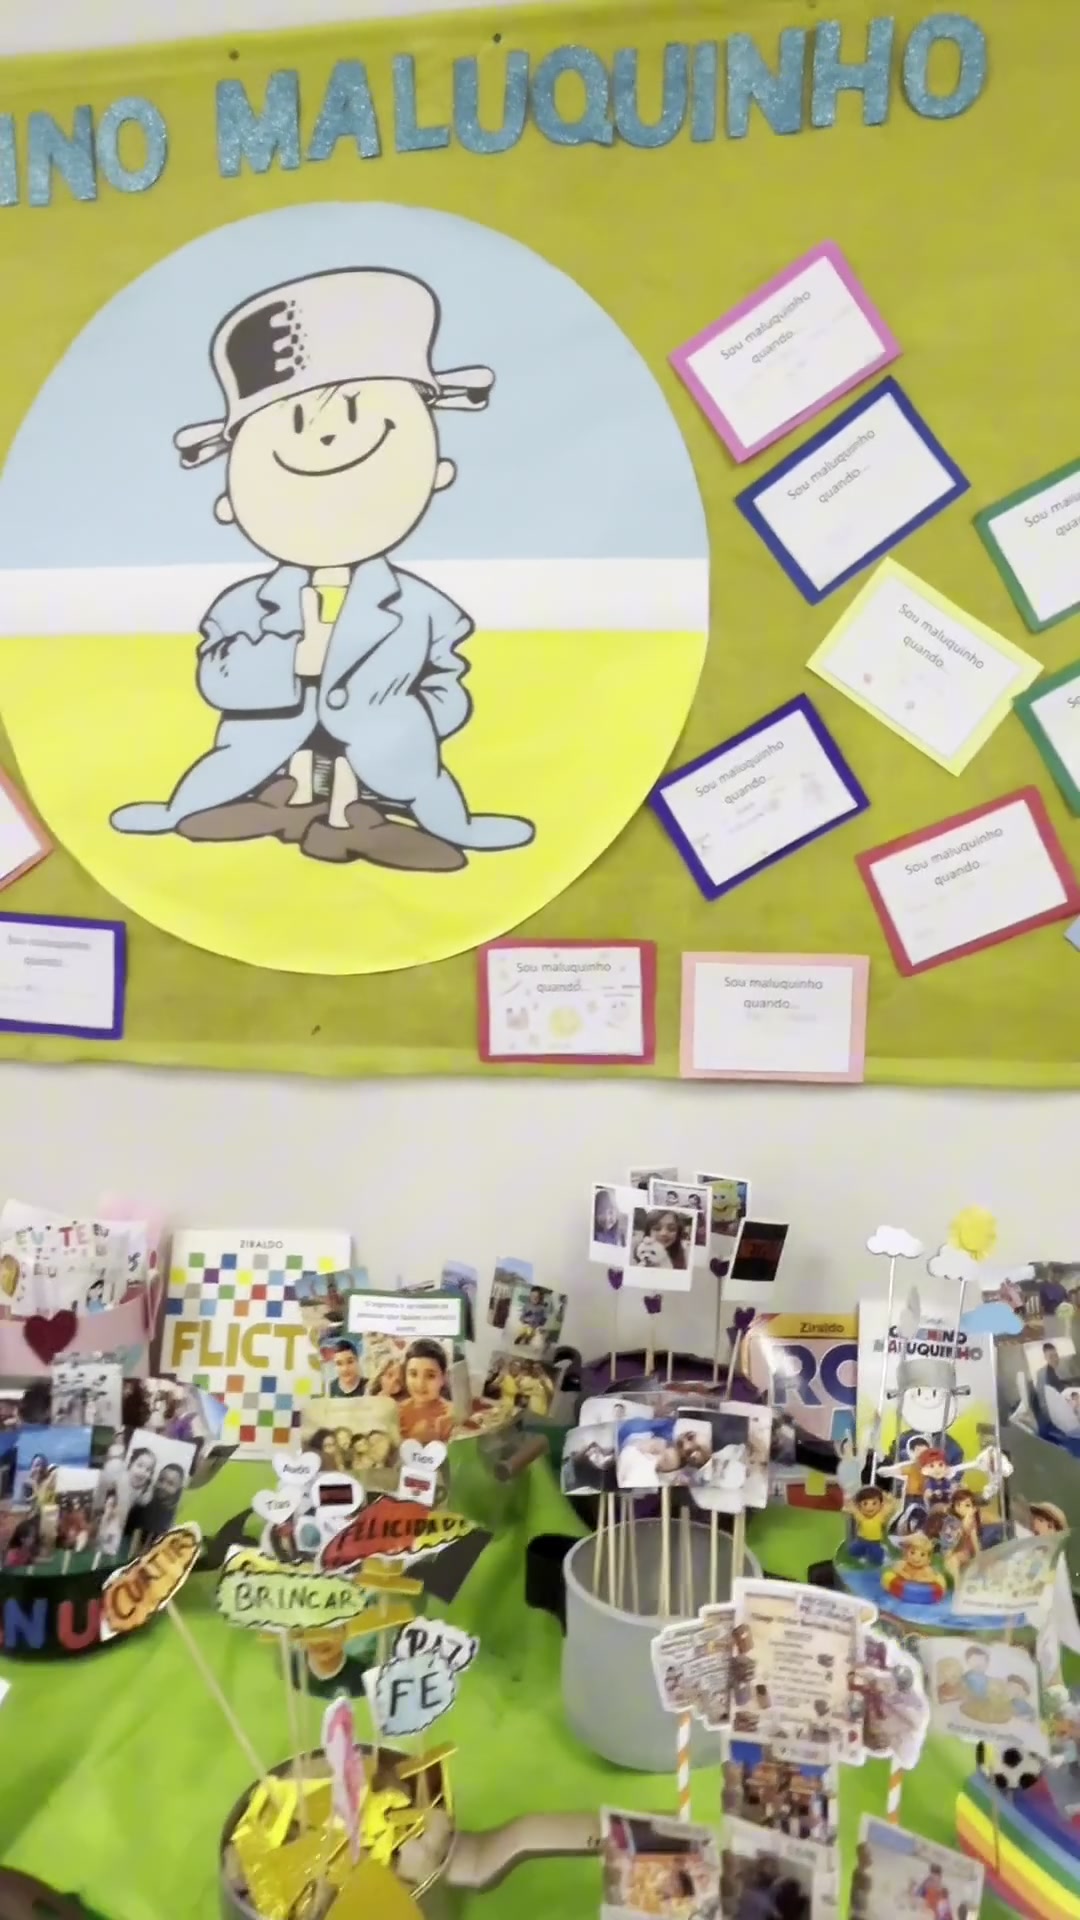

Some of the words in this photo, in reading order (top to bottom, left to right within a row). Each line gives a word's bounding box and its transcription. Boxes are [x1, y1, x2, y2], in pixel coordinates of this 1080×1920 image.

[216, 13, 987, 178] MALUQUINHO
[720, 341, 744, 360] Sou
[745, 291, 811, 343] maluquinho
[787, 481, 810, 500] Sou
[810, 430, 875, 483] maluquinho
[1024, 511, 1048, 528] Sou
[899, 603, 920, 624] Sou
[921, 621, 984, 669] maluquinho
[695, 781, 718, 797] Sou
[719, 741, 784, 784] maluquinho
[905, 860, 929, 875] Sou
[930, 828, 1003, 863] maluquinho
[515, 962, 538, 973] Sou
[541, 962, 612, 973] maluquinho
[724, 976, 746, 988] Sou
[749, 978, 823, 990] maluquinho
[800, 1322, 845, 1333] Ziraldo
[236, 1582, 357, 1612] BRINCAR
